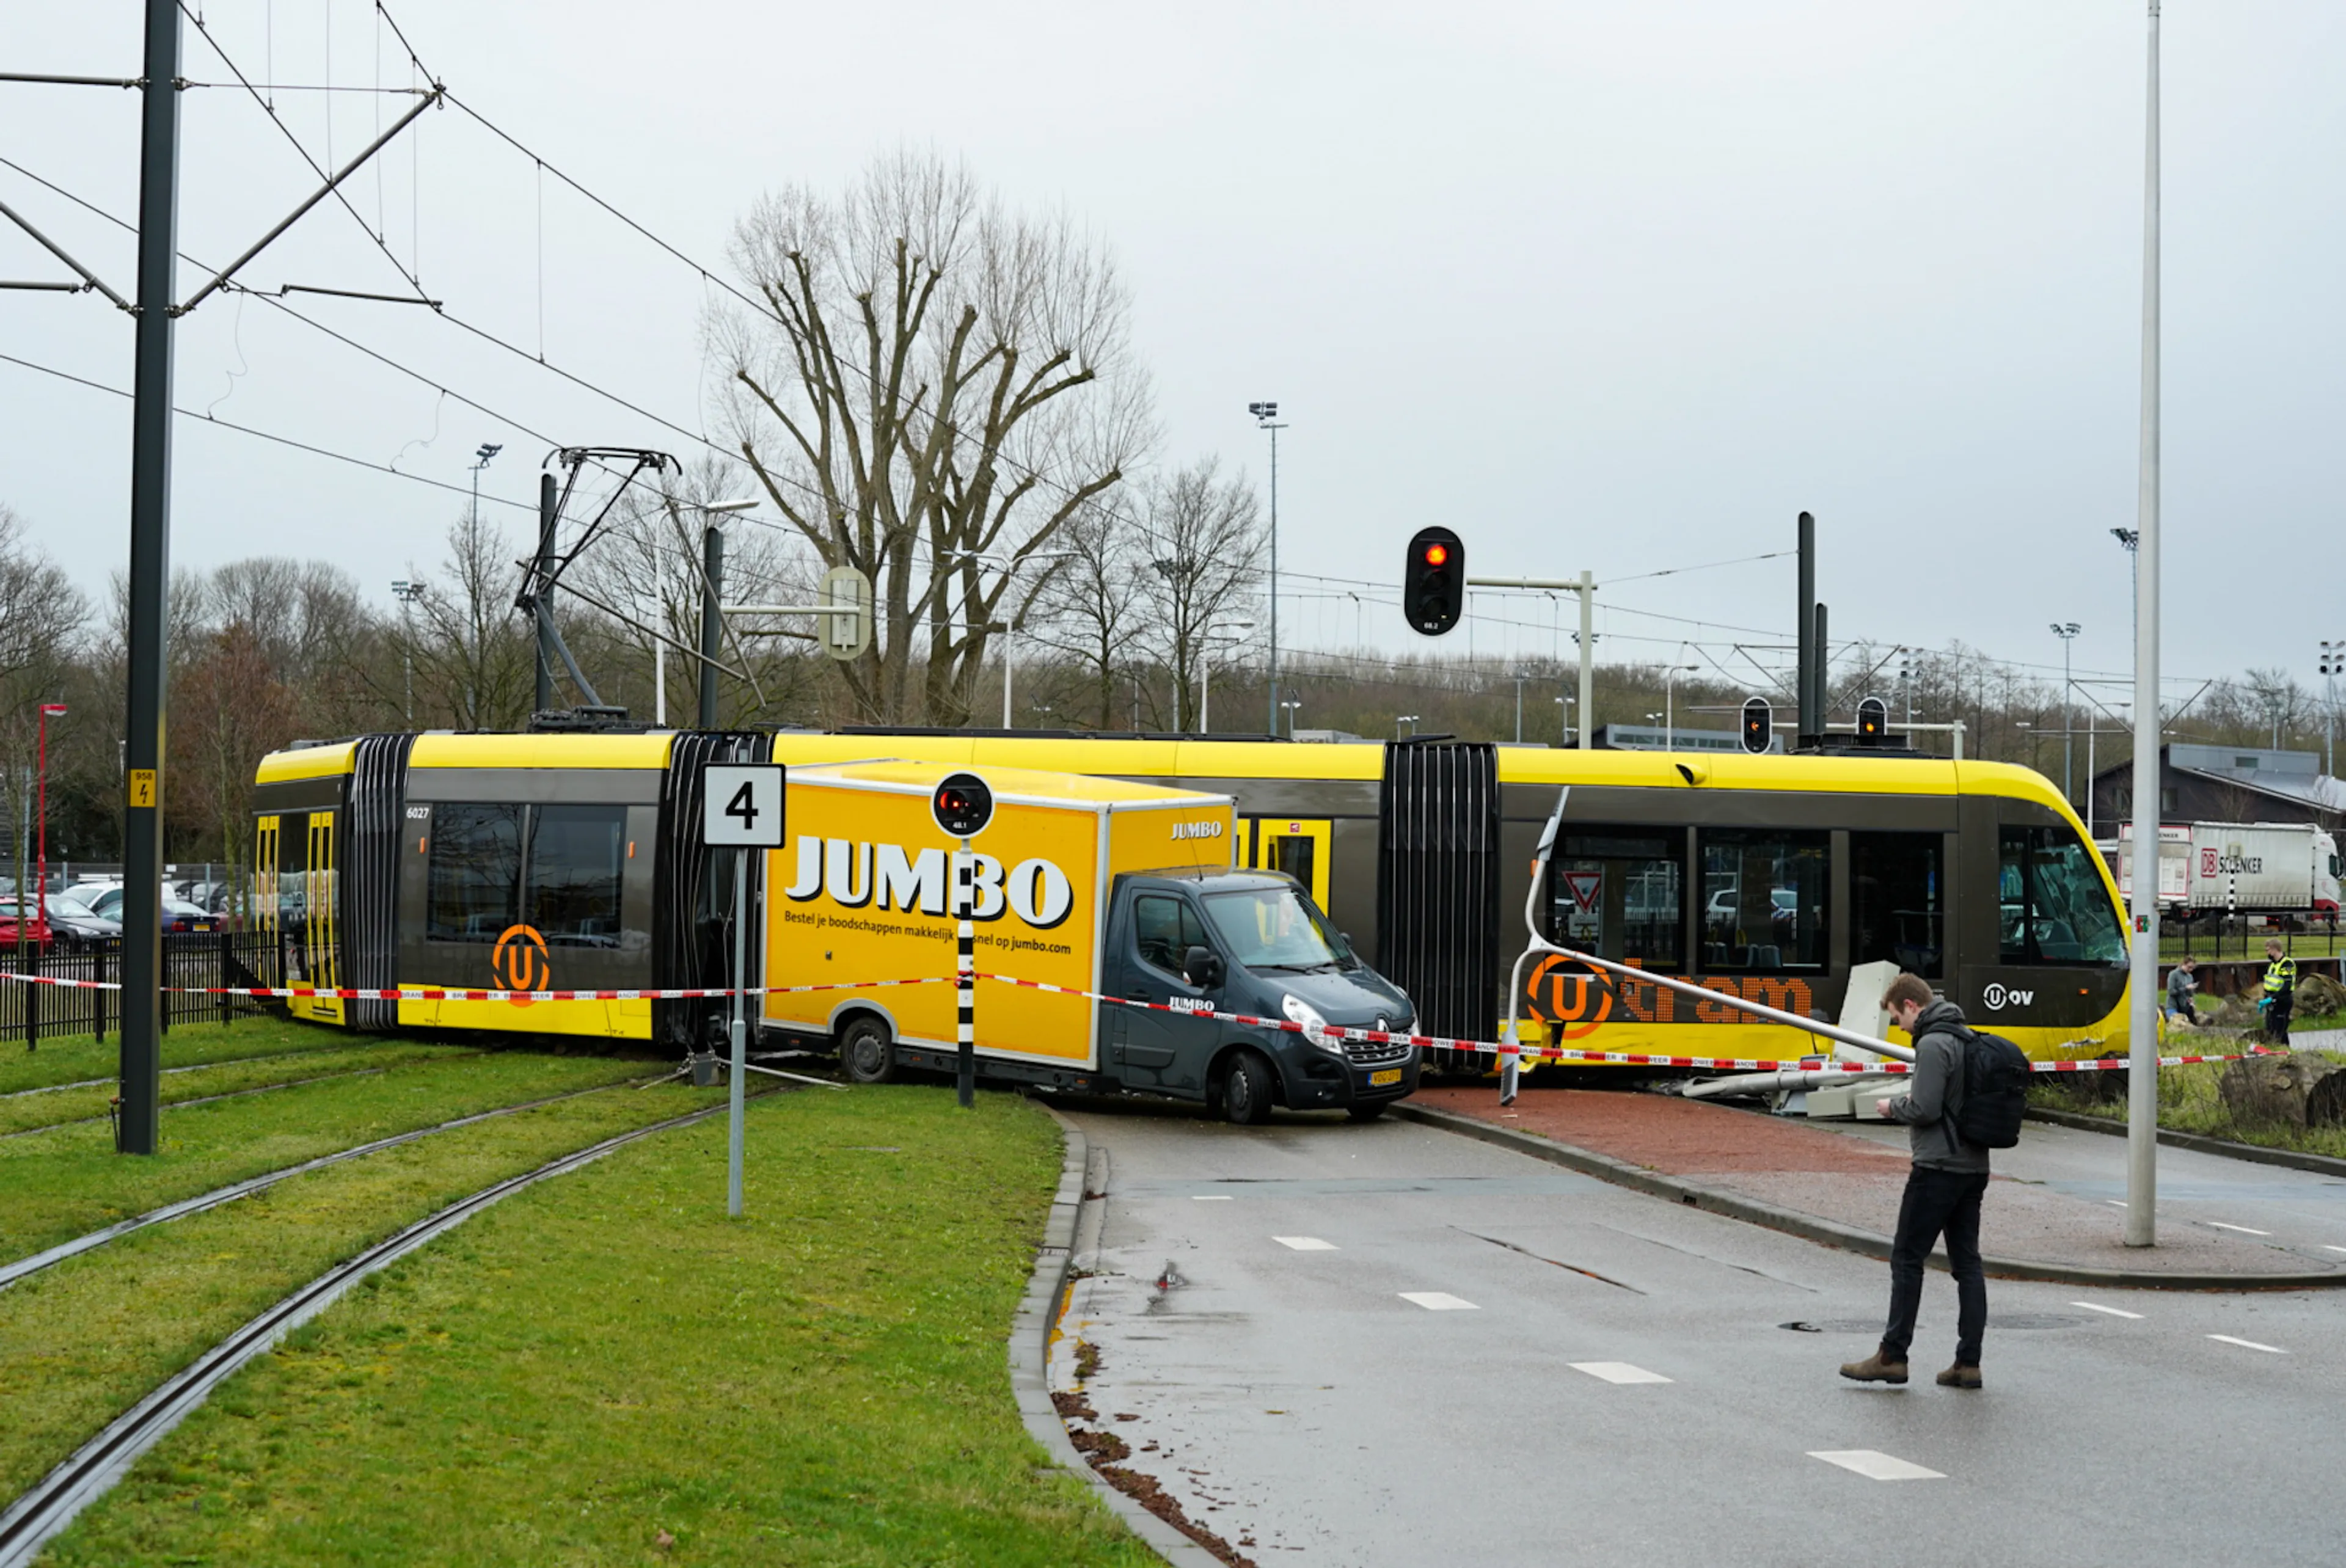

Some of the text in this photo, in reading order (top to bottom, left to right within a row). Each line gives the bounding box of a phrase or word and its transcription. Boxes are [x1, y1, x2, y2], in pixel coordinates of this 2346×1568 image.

[136, 771, 153, 781] 958
[406, 807, 429, 819] 6027
[725, 781, 758, 830] 4
[1170, 820, 1222, 841] JUMBO
[2203, 853, 2215, 873] DB
[785, 835, 1073, 930] JUMBO
[785, 910, 815, 925] Bestel
[816, 914, 827, 928] je
[828, 915, 902, 936] boodschappen
[905, 926, 954, 944] makkelijk
[973, 933, 994, 946] snel
[996, 937, 1010, 950] op
[1011, 936, 1071, 955] jumbo.com
[1620, 957, 1812, 1023] tram
[1169, 996, 1215, 1012] JUMBO
